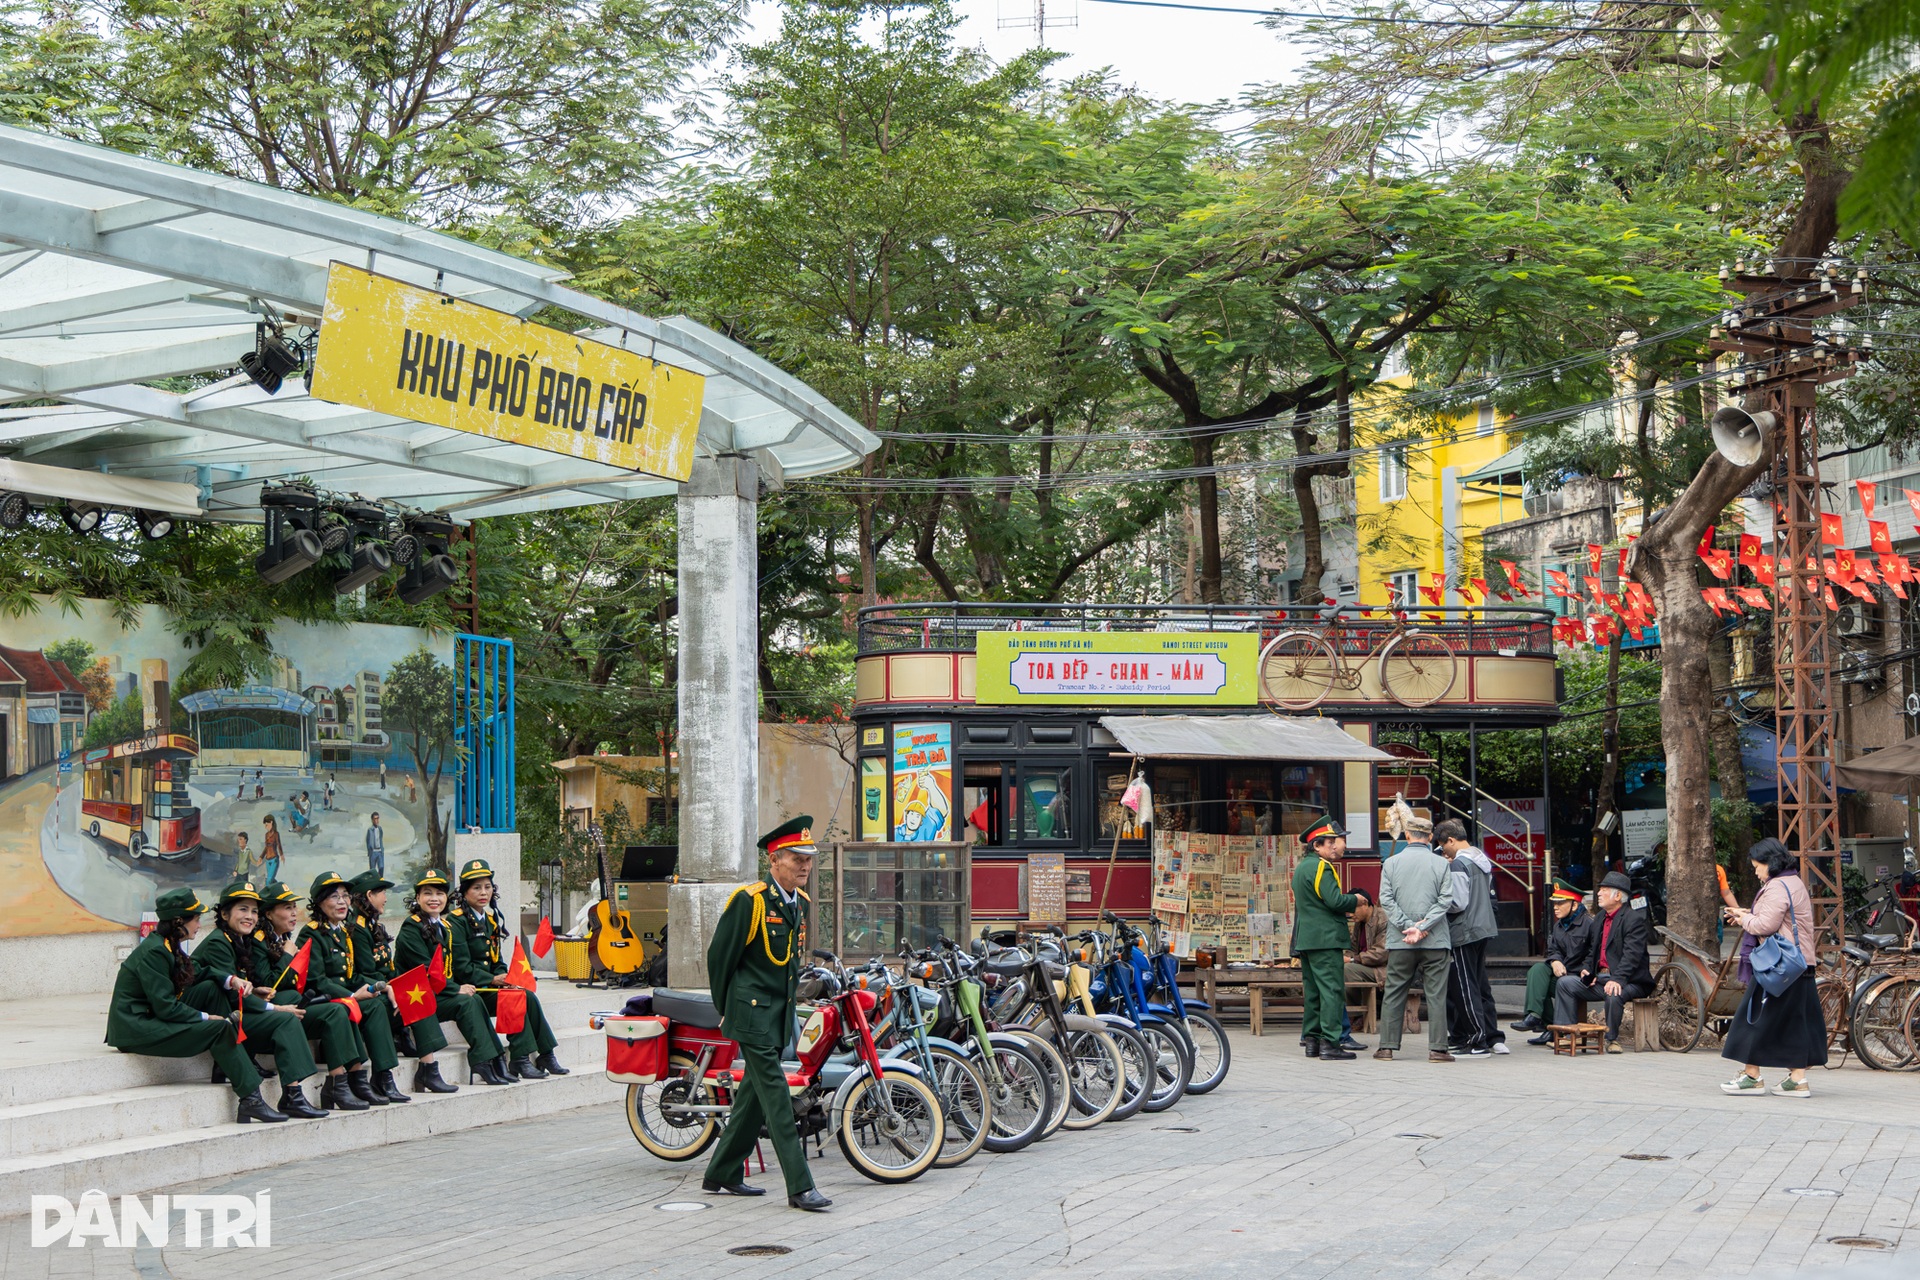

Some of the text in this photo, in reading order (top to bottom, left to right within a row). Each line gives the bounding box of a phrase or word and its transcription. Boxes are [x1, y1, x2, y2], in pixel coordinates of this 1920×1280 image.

[397, 328, 647, 444] KHU PHỐ BAO CẤP
[1162, 641, 1228, 649] HANOI STREET MUSEUM
[1028, 662, 1055, 680] TOA
[1062, 658, 1088, 680] BẾP
[1110, 662, 1149, 684] CHẠN
[1171, 659, 1204, 681] MÂM
[1116, 684, 1144, 692] Subsidy
[911, 733, 939, 746] WORK
[905, 750, 928, 767] TRÀ
[1495, 851, 1513, 861] PHỞ
